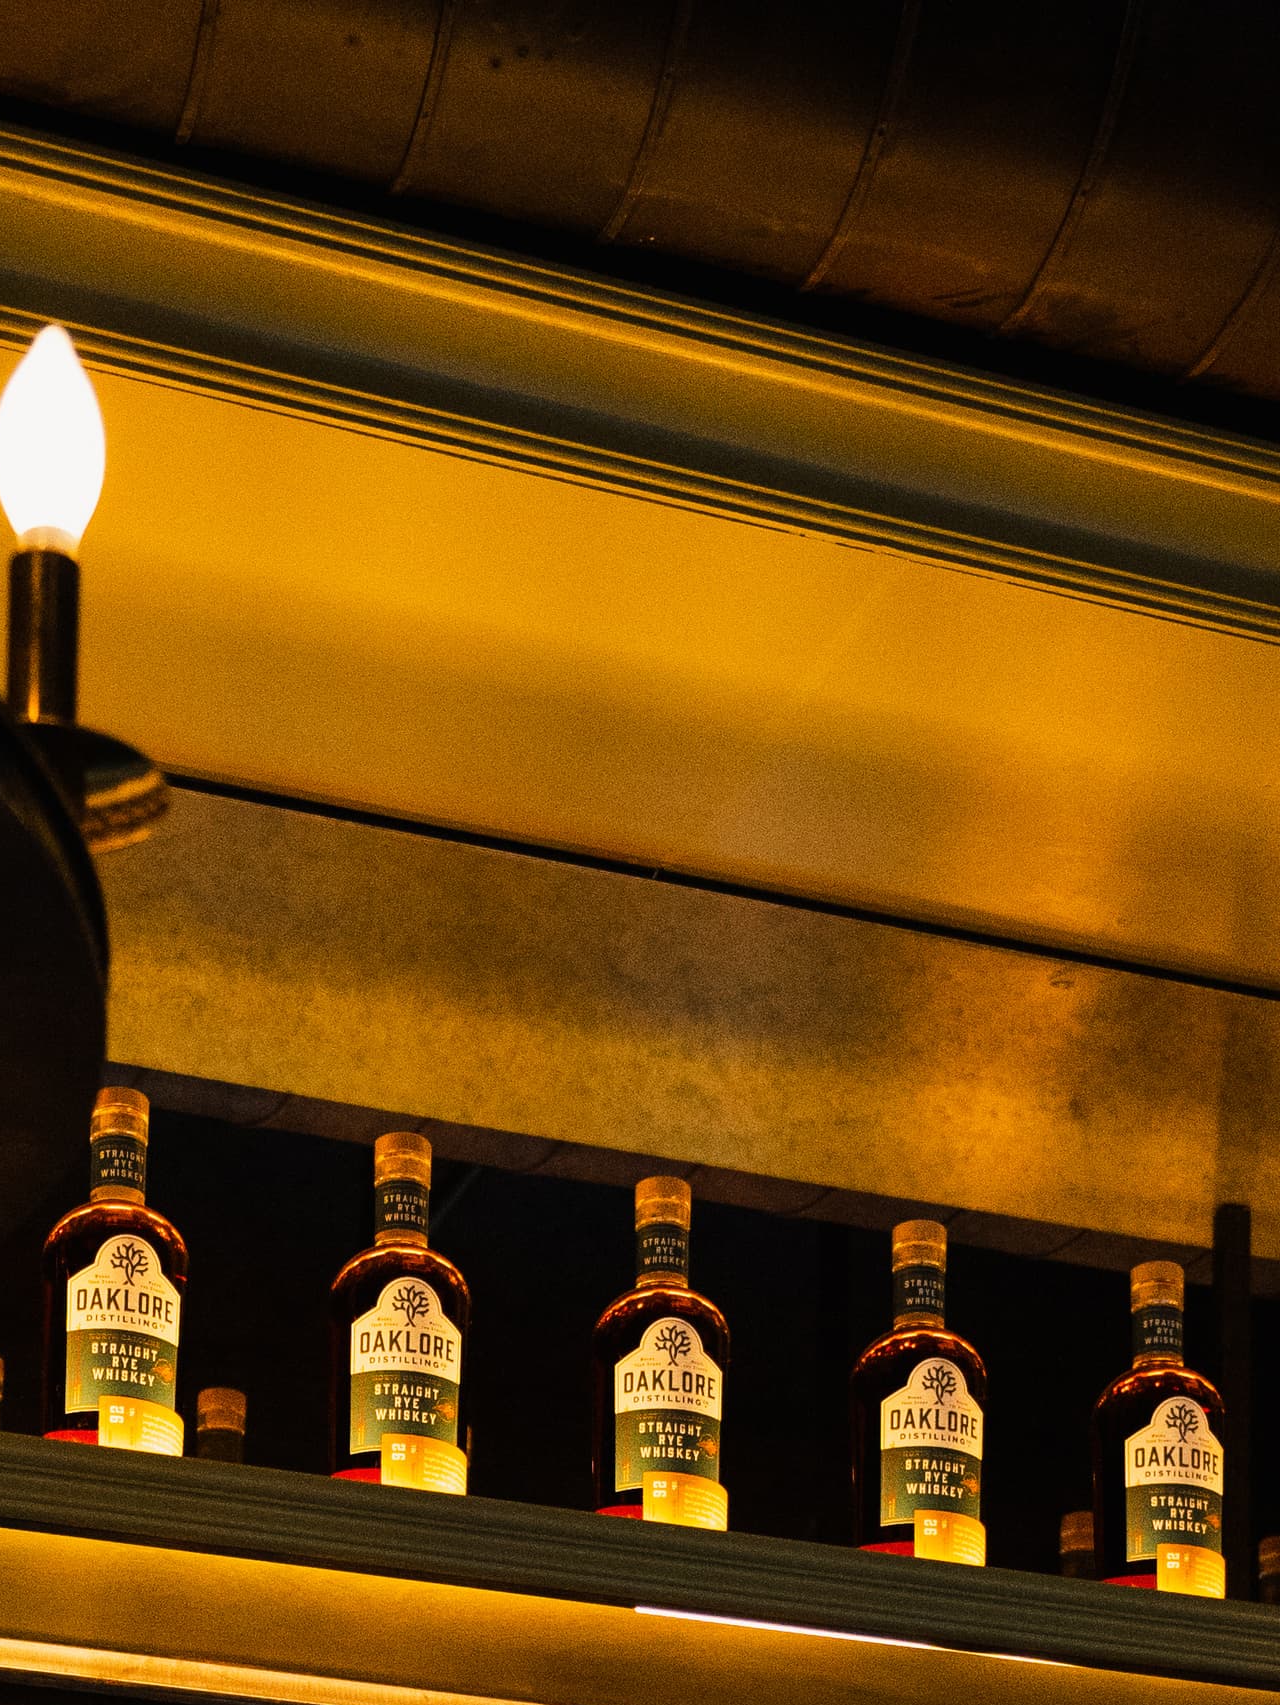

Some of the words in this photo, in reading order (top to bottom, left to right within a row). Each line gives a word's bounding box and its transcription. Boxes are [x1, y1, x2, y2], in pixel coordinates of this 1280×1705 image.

[77, 1289, 173, 1323] OAKLORE
[86, 1314, 158, 1329] DISTILLING
[91, 1342, 157, 1361] STRAIGHT
[360, 1331, 455, 1360] OAKLORE
[112, 1356, 138, 1369] RYE
[92, 1368, 155, 1386] WHISKEY
[624, 1370, 715, 1399] OAKLORE
[374, 1383, 439, 1400] STRAIGHT
[395, 1397, 419, 1409] RYE
[375, 1408, 437, 1425] WHISKEY
[891, 1409, 977, 1439] OAKLORE
[1135, 1447, 1218, 1475] OAKLORE
